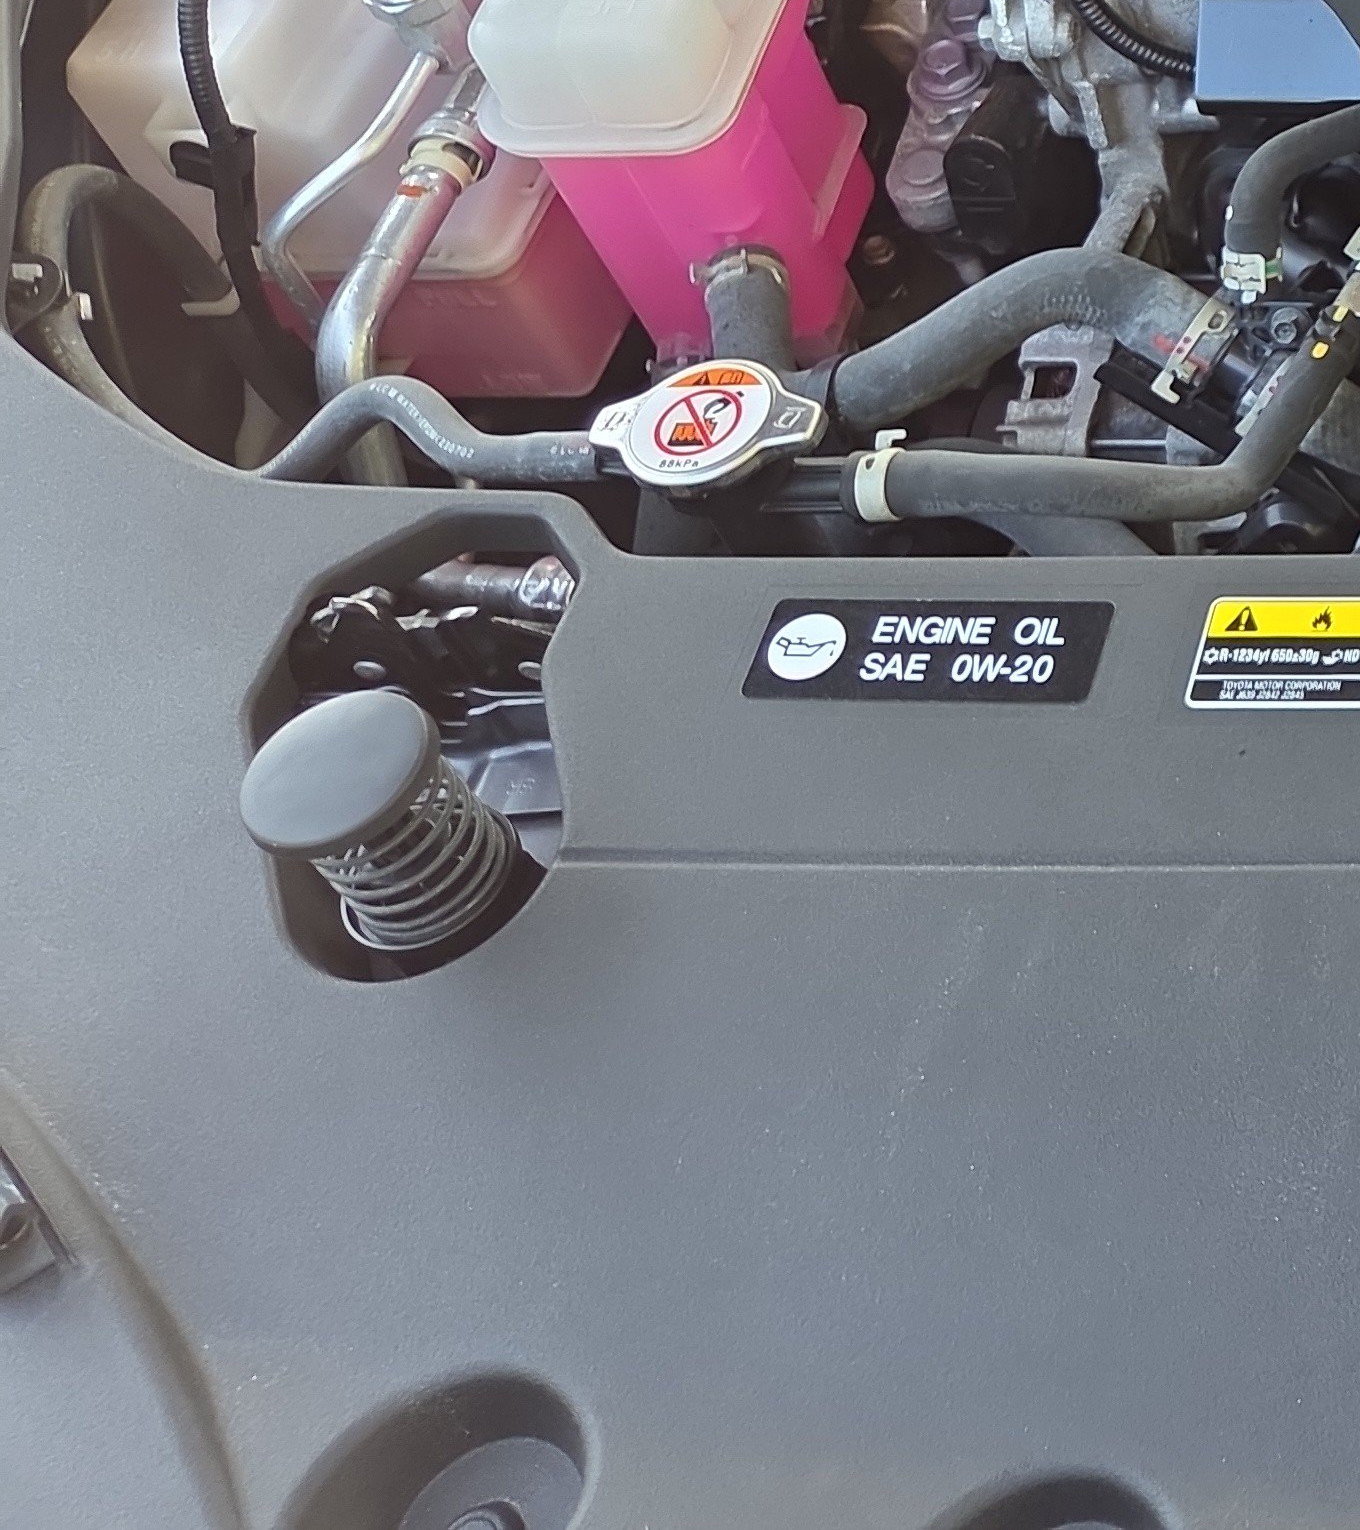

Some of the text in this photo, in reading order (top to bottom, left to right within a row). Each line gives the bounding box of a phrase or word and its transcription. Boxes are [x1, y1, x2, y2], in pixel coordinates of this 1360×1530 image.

[658, 459, 700, 469] 88kPa
[871, 615, 1065, 646] ENGINE OIL
[1218, 647, 1271, 665] R-1234yf
[859, 652, 1055, 684] SAE 0W-20
[1222, 680, 1342, 691] TOYOTA MOTOR CORPORATION
